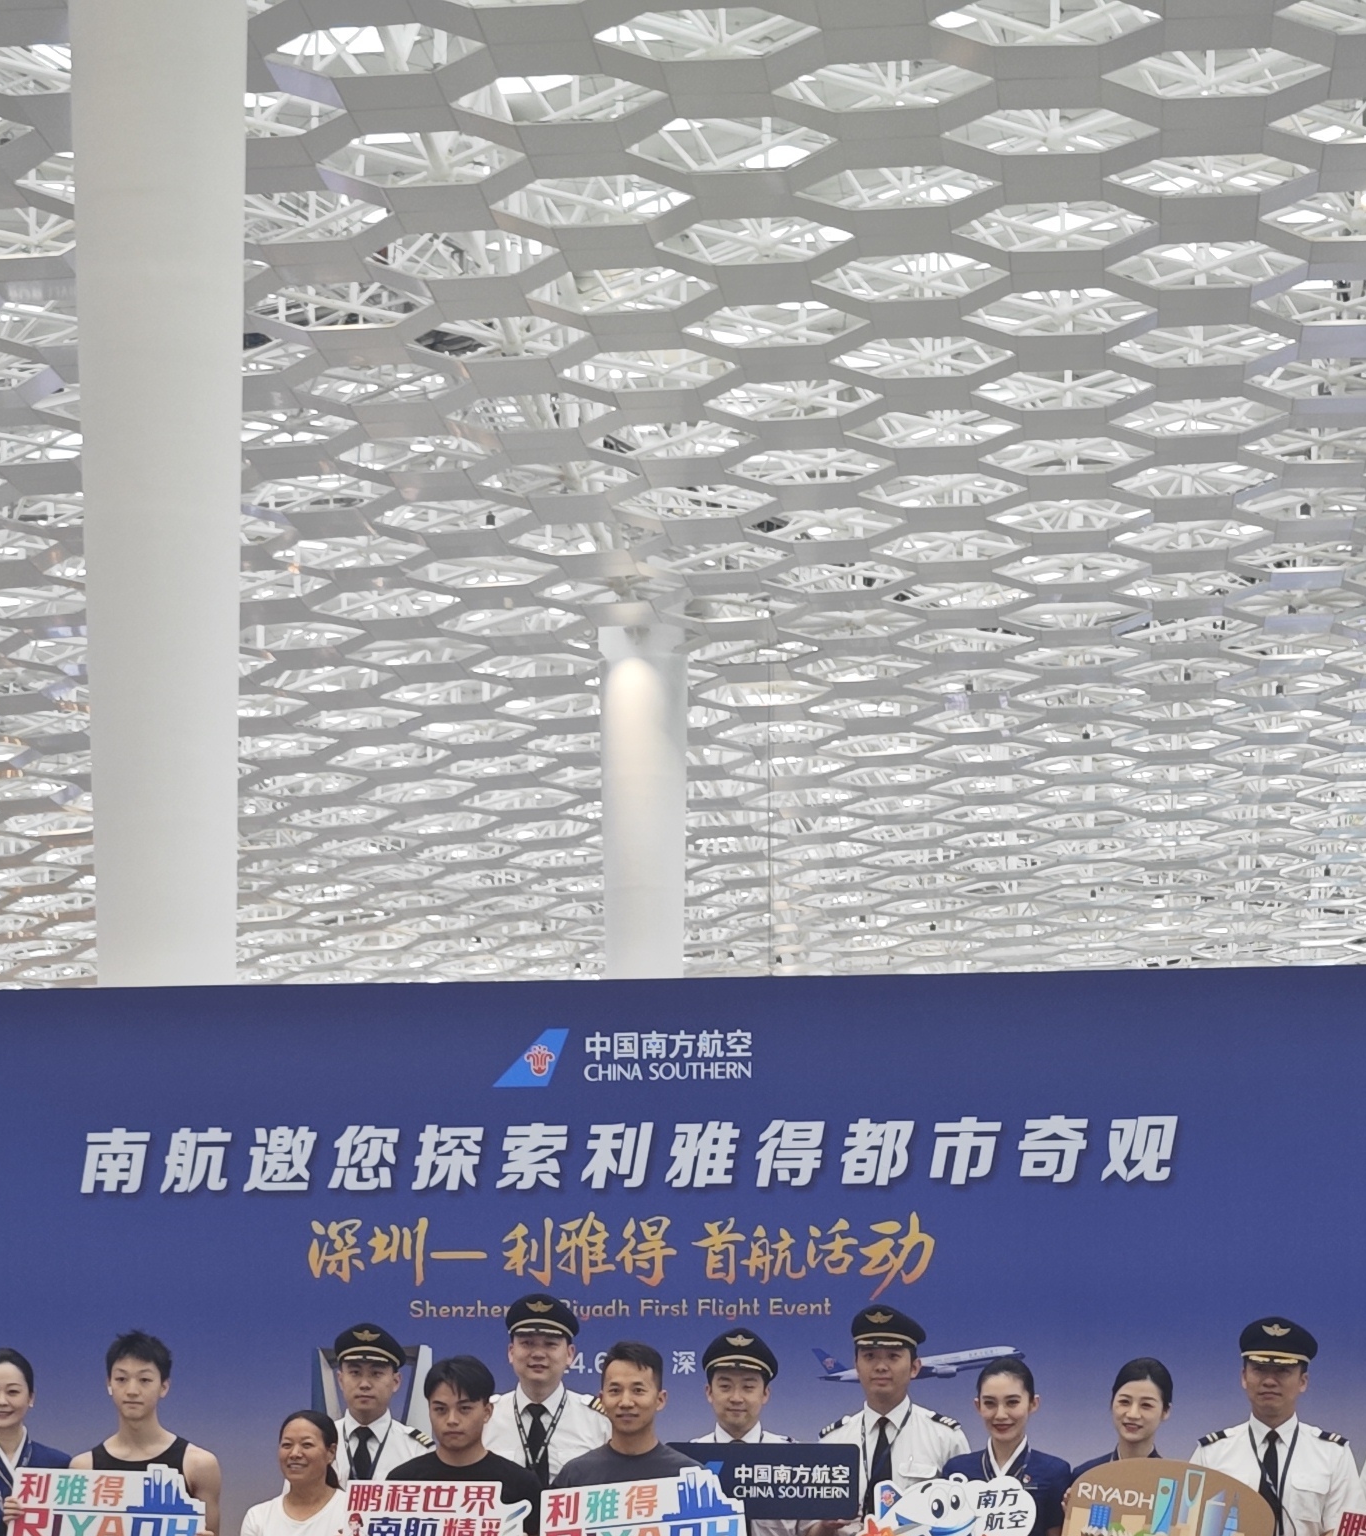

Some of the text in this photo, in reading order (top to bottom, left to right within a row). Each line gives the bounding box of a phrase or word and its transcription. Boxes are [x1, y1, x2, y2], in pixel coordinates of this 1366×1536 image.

[585, 1029, 752, 1061] 中国南方航空
[584, 1061, 752, 1082] CHINA SOUTHERN
[80, 1115, 1178, 1194] 南航邀您探索利雅得都市奇观
[691, 1211, 936, 1300] 首航活动
[640, 1299, 688, 1318] First
[697, 1298, 761, 1321] Flight
[769, 1298, 832, 1317] Event
[18, 1472, 125, 1507] 利雅得
[734, 1464, 851, 1486] 中国南方航空
[347, 1484, 497, 1517] 鹏程世界
[546, 1485, 658, 1526] 利雅得
[733, 1484, 851, 1499] CHINA SOUTHERN
[976, 1487, 1020, 1510] 南方
[1077, 1481, 1155, 1511] RIYADH
[983, 1509, 1029, 1532] 航空
